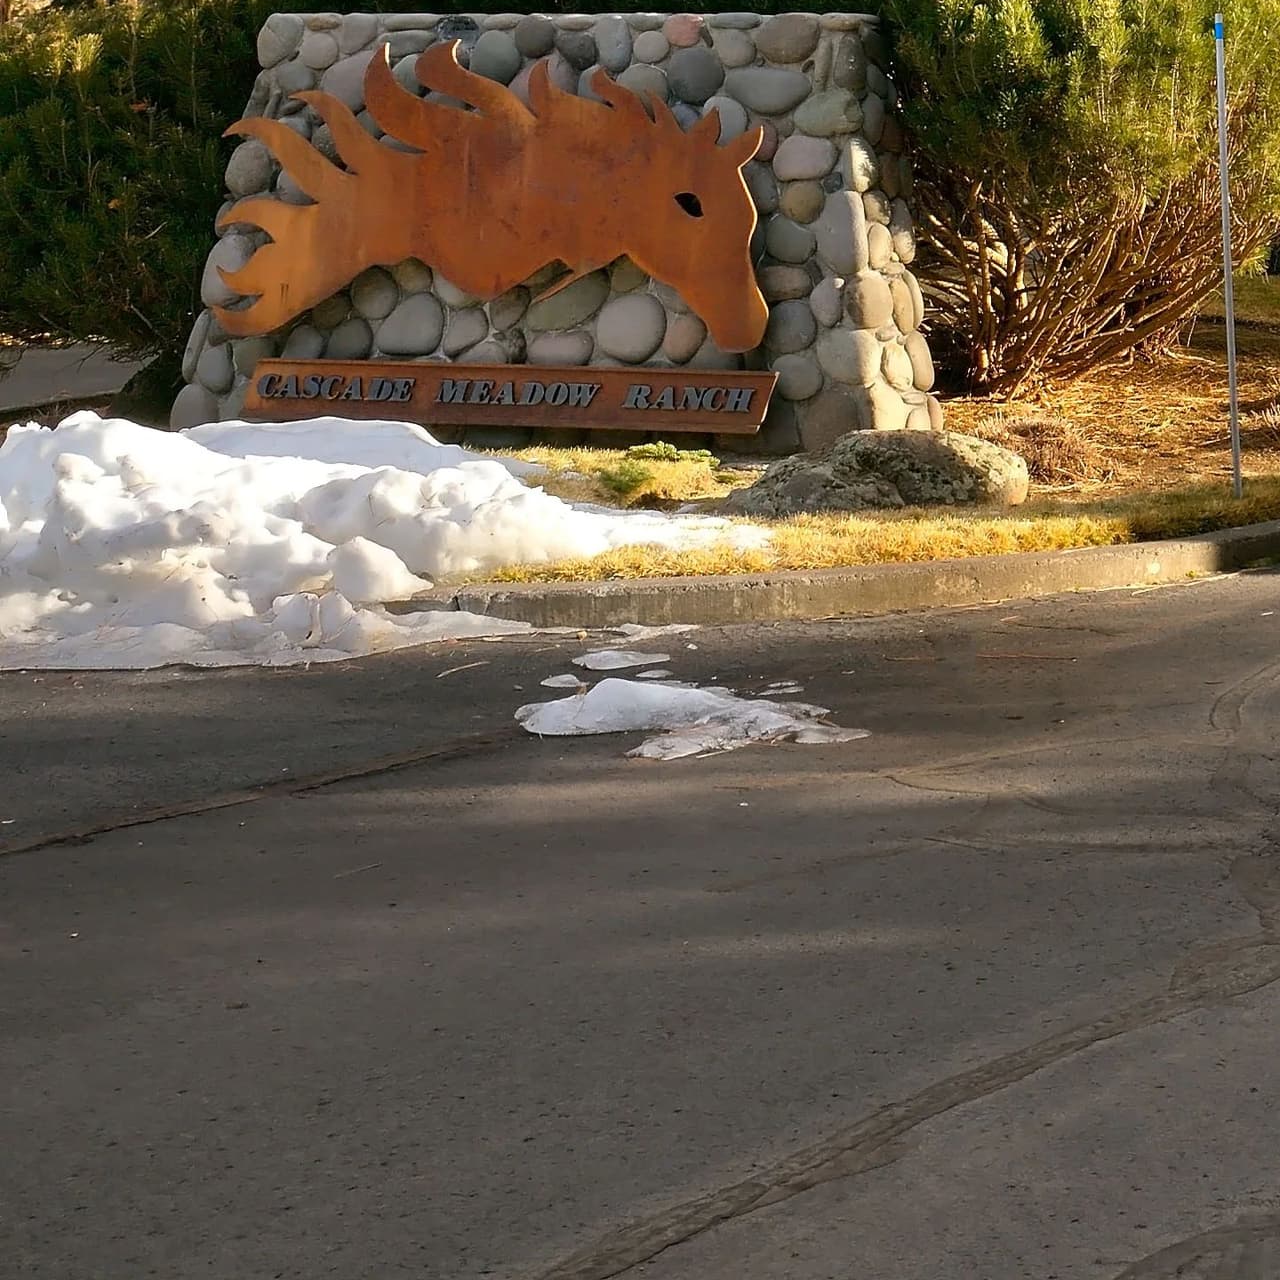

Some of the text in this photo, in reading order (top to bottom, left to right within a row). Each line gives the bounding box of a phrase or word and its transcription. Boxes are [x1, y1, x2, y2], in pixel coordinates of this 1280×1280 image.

[257, 373, 757, 412] CASCADE MEADOW RANCH
